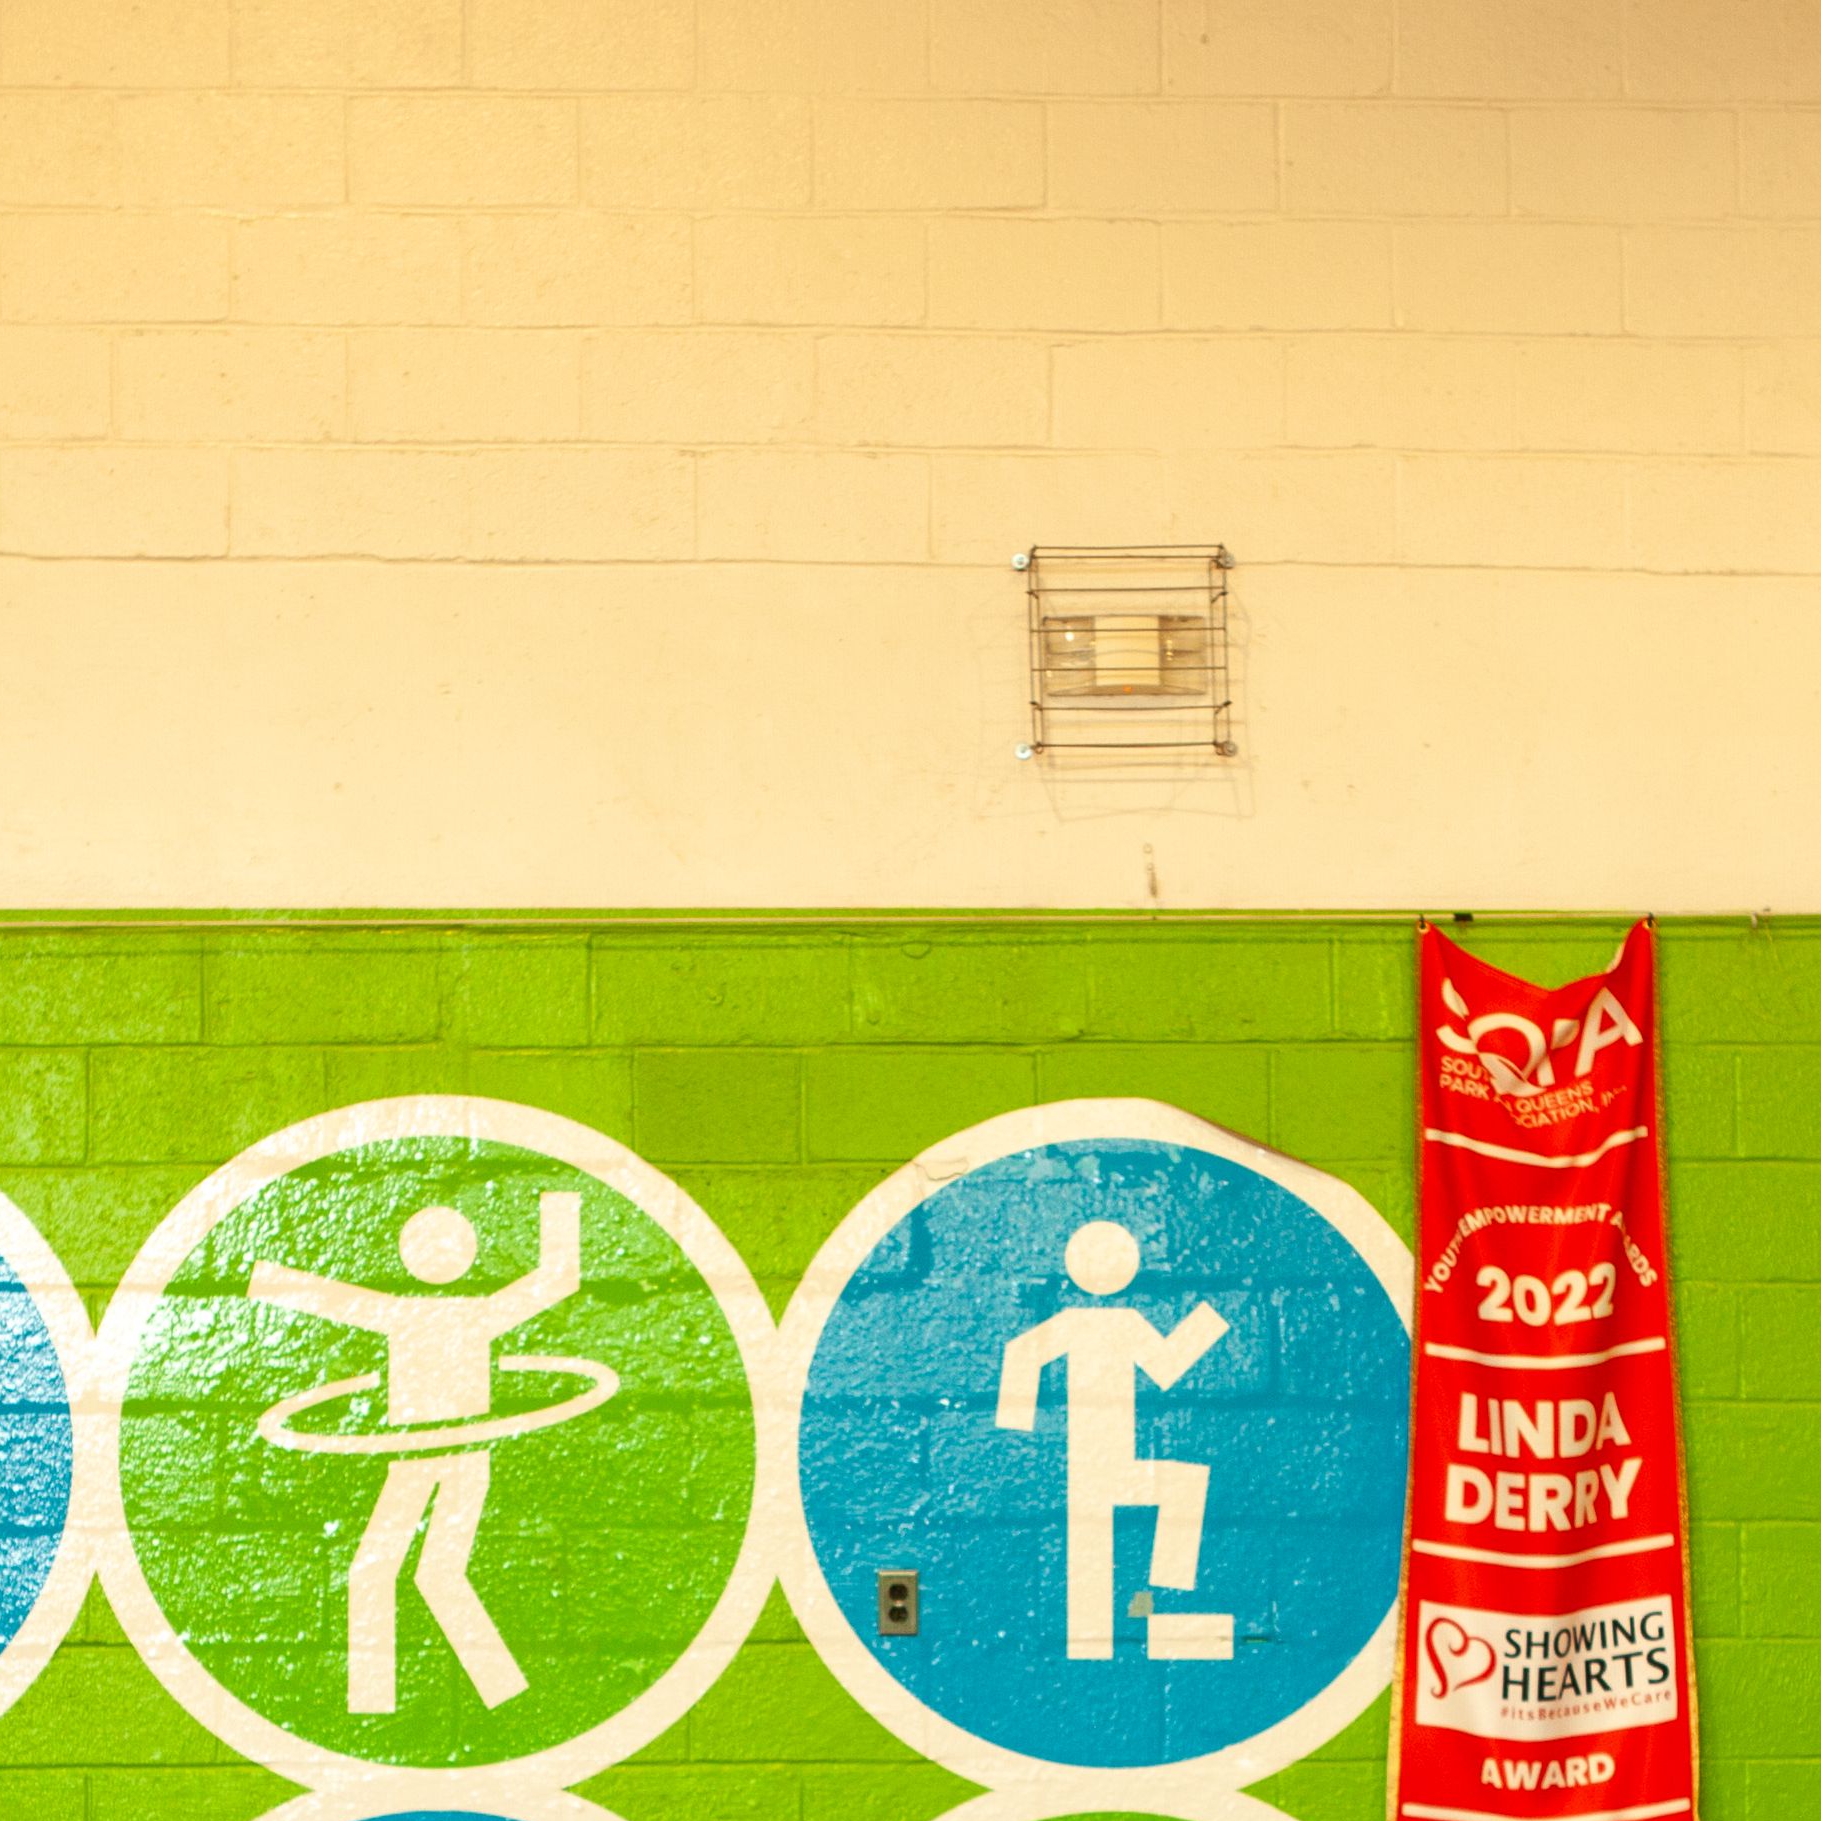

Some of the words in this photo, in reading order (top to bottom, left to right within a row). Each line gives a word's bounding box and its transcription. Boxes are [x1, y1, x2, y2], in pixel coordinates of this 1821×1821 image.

[1439, 1073, 1490, 1101] PARK
[1515, 1080, 1595, 1115] QUEENS
[1459, 1202, 1613, 1238] EMPOWERMENT
[1475, 1261, 1617, 1328] 2022
[1457, 1390, 1632, 1460] LINDA
[1443, 1456, 1643, 1533] DERRY
[1504, 1610, 1665, 1661] SHOWING
[1501, 1646, 1670, 1703] HEARTS
[1480, 1752, 1616, 1791] AWARD
